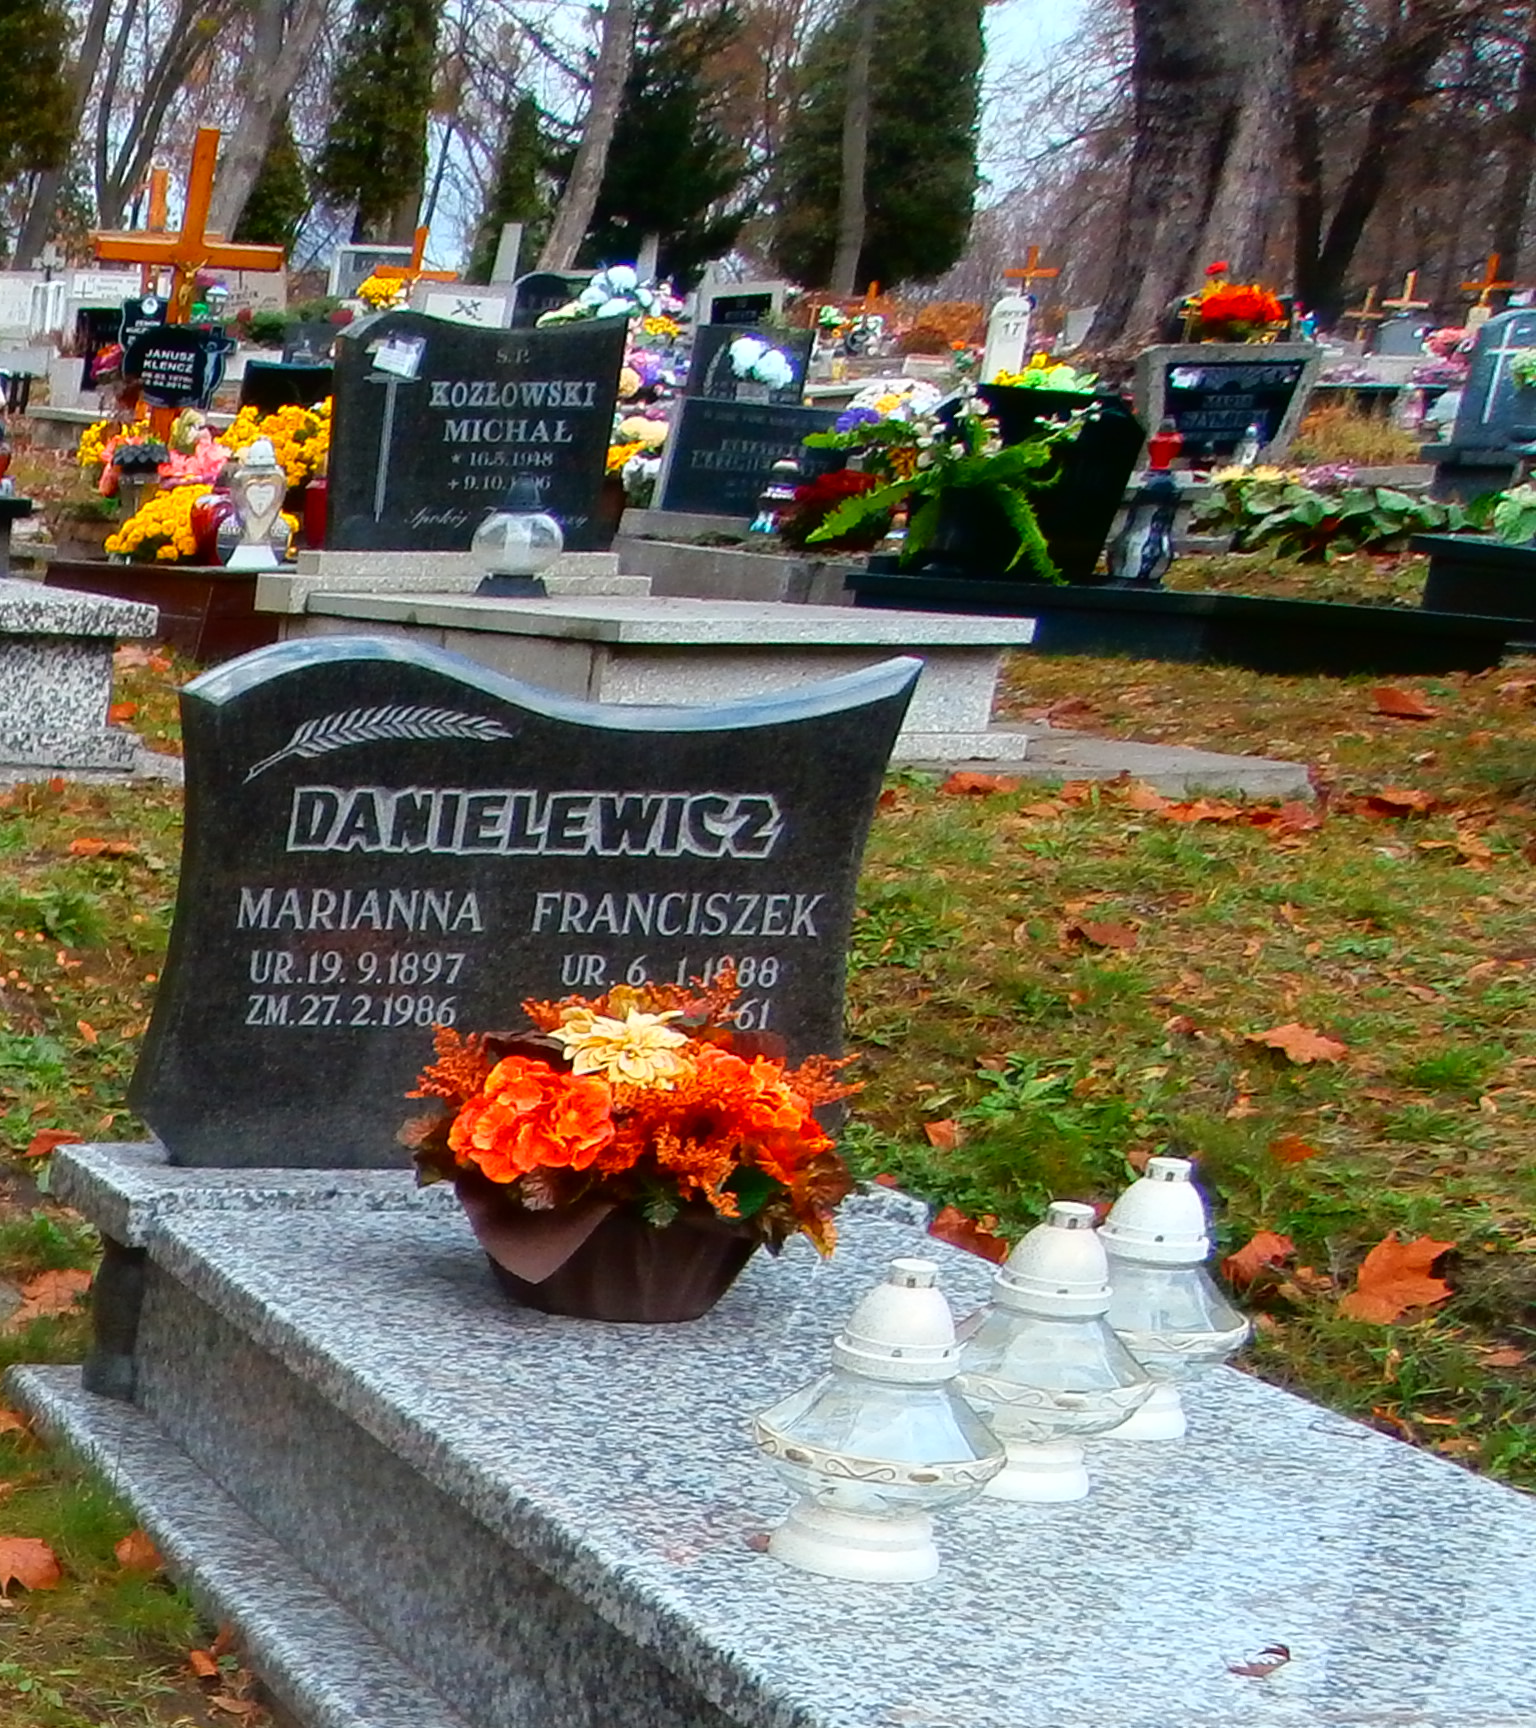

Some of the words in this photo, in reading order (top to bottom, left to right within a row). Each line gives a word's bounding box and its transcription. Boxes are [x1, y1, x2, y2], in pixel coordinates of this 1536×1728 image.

[143, 359, 195, 374] KLENCZ
[144, 349, 196, 362] JANUSZ
[428, 379, 598, 409] KOZŁOWSKI
[442, 418, 573, 444] MICHAŁ
[285, 786, 786, 860] DANIELEWICZ
[235, 886, 485, 933] MARIANNA
[530, 890, 826, 941] FRANCISZEK
